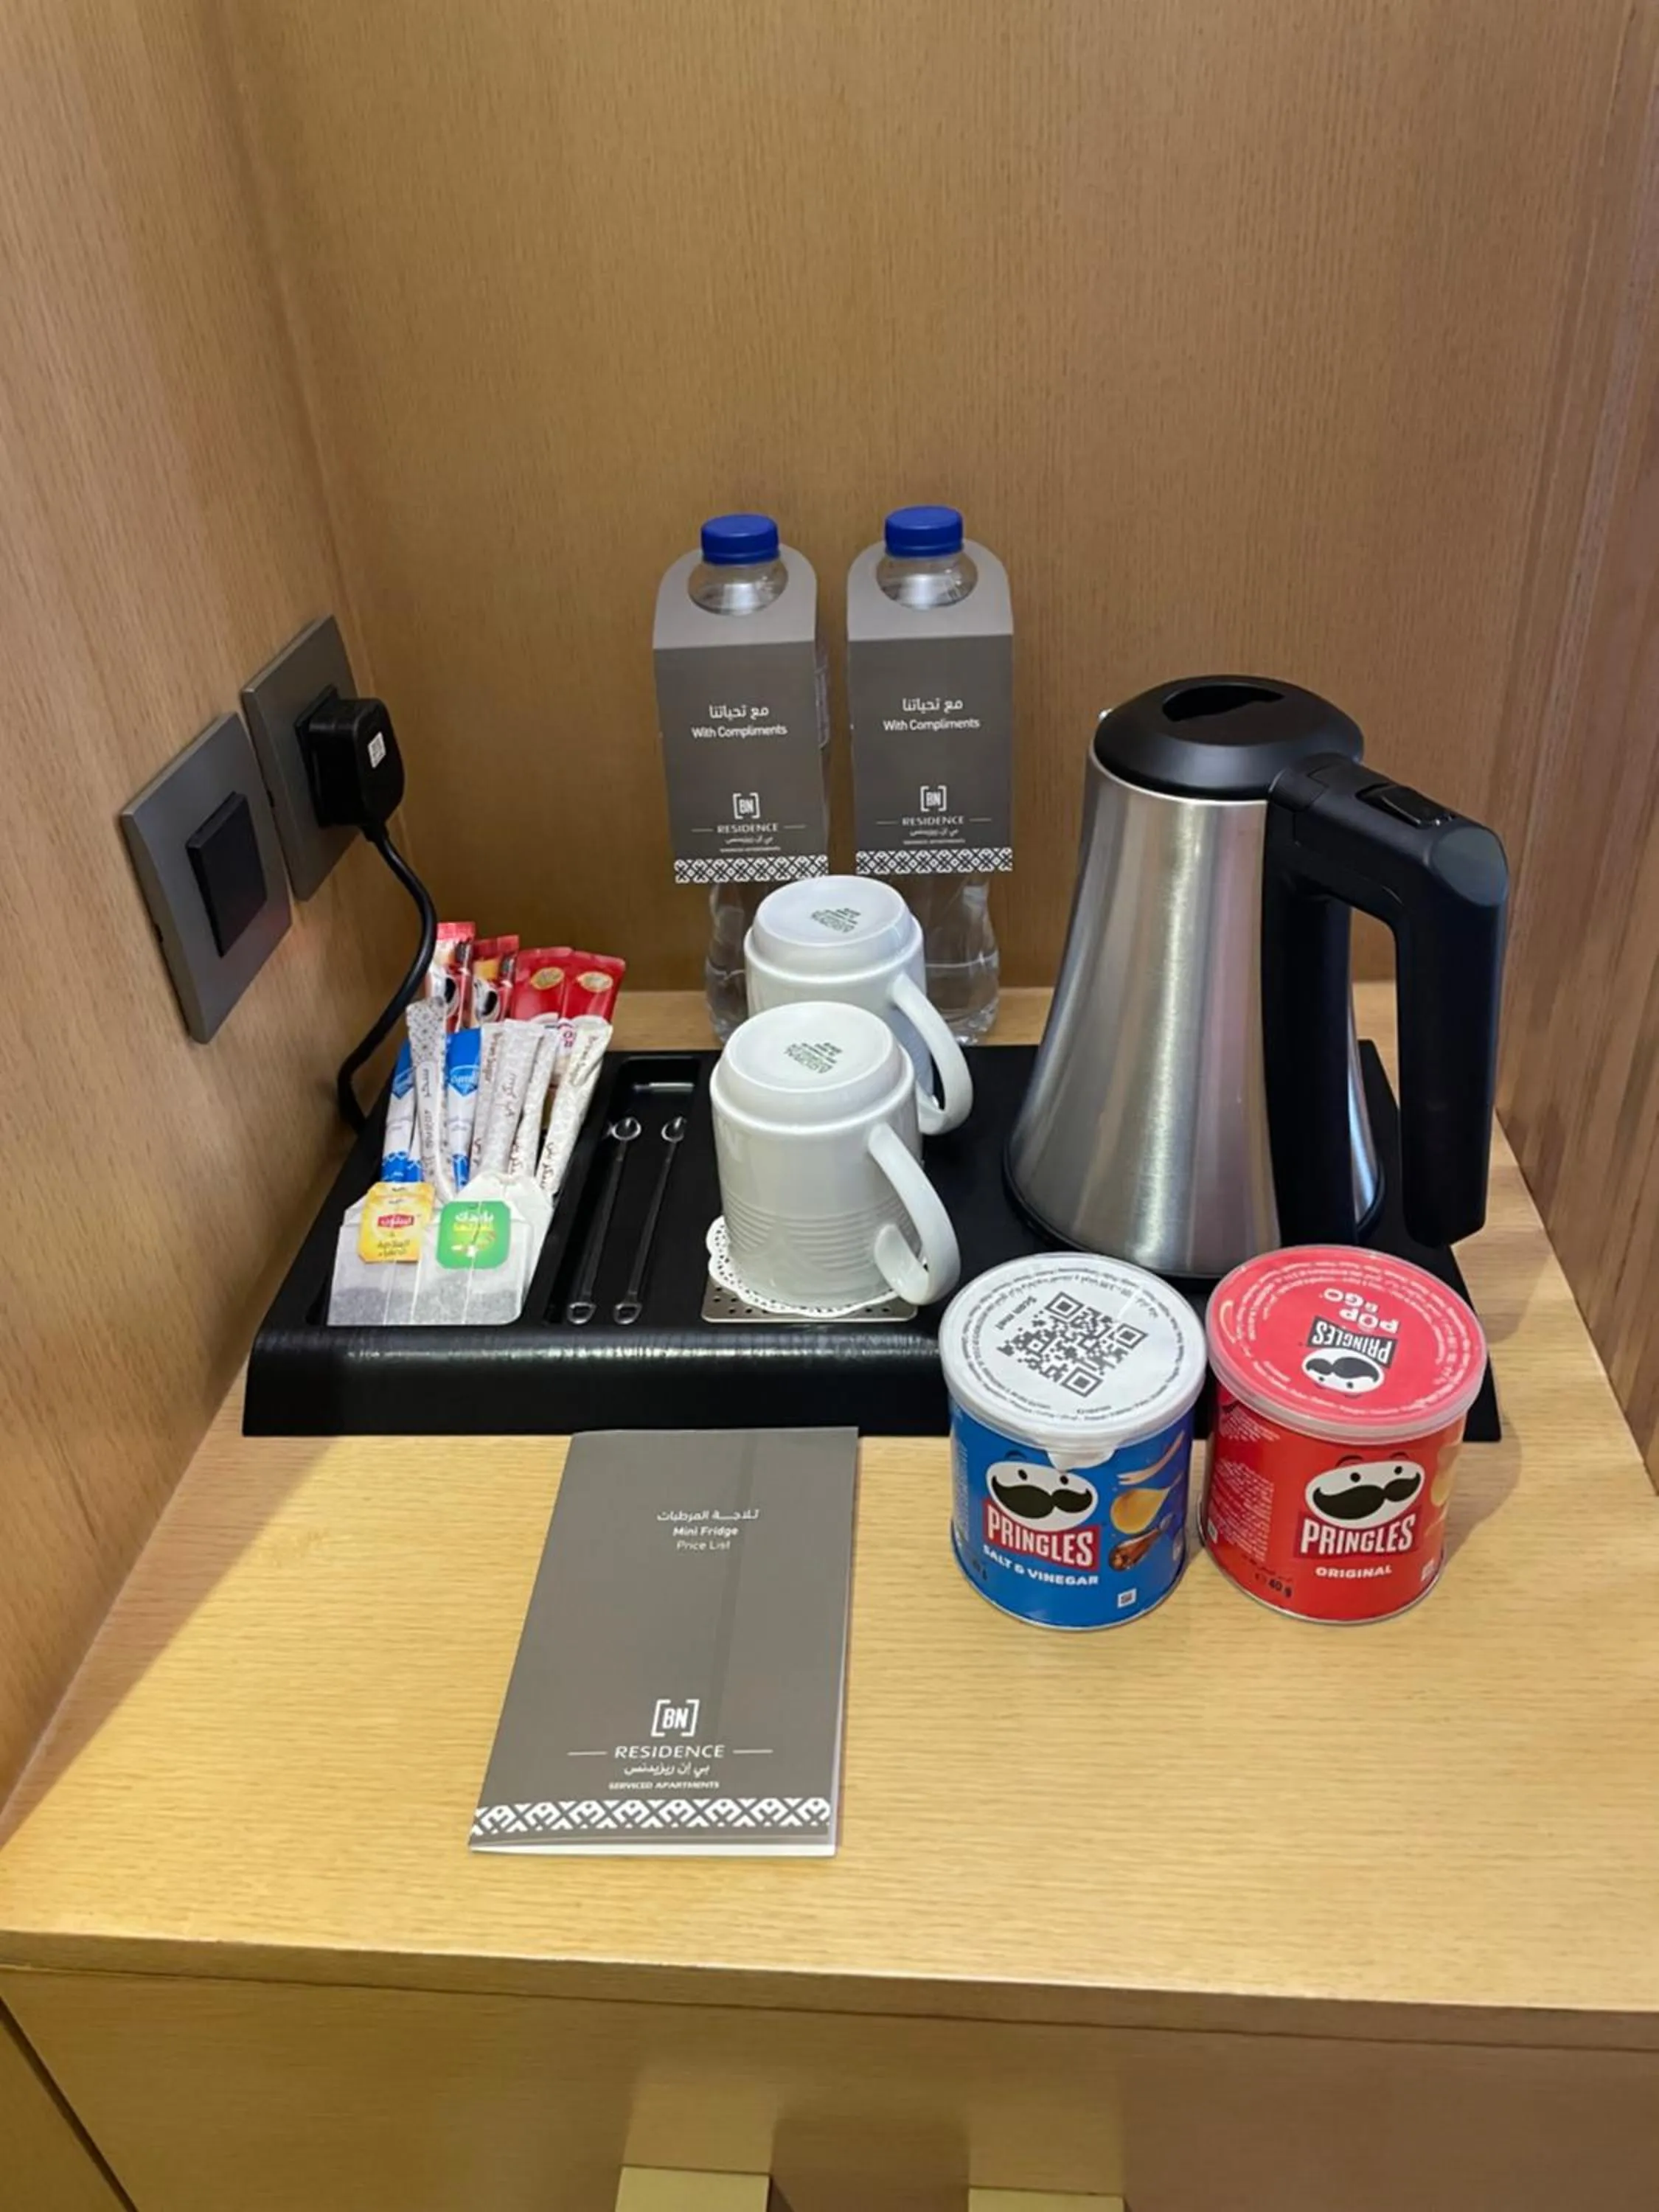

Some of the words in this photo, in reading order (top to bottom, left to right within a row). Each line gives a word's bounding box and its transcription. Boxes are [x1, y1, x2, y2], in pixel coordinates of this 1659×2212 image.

[709, 704, 747, 721] تحياتنا
[750, 706, 769, 720] مع
[902, 698, 940, 714] تحياتنا
[944, 699, 964, 714] مع
[691, 726, 717, 739] With
[717, 724, 788, 739] Compliments
[883, 719, 908, 731] With
[909, 717, 981, 732] Compliments
[717, 822, 779, 834] RESIDENCE
[902, 815, 964, 827] RESIDENCE
[1324, 1288, 1366, 1307] GO
[1339, 1308, 1400, 1334] POP
[1312, 1321, 1394, 1363] PRINGLES
[672, 1526, 698, 1537] Mini
[700, 1526, 740, 1539] Fridge
[987, 1503, 1093, 1568] PRINGLES
[1300, 1514, 1416, 1556] PRINGLES
[677, 1540, 706, 1551] Price
[709, 1540, 731, 1551] List
[983, 1545, 1012, 1570] SALT
[1027, 1569, 1099, 1586] VINEGAR
[1315, 1565, 1393, 1579] ORIGINAL
[614, 1745, 726, 1759] RESIDENCE
[655, 1781, 720, 1790] APARTMENTS
